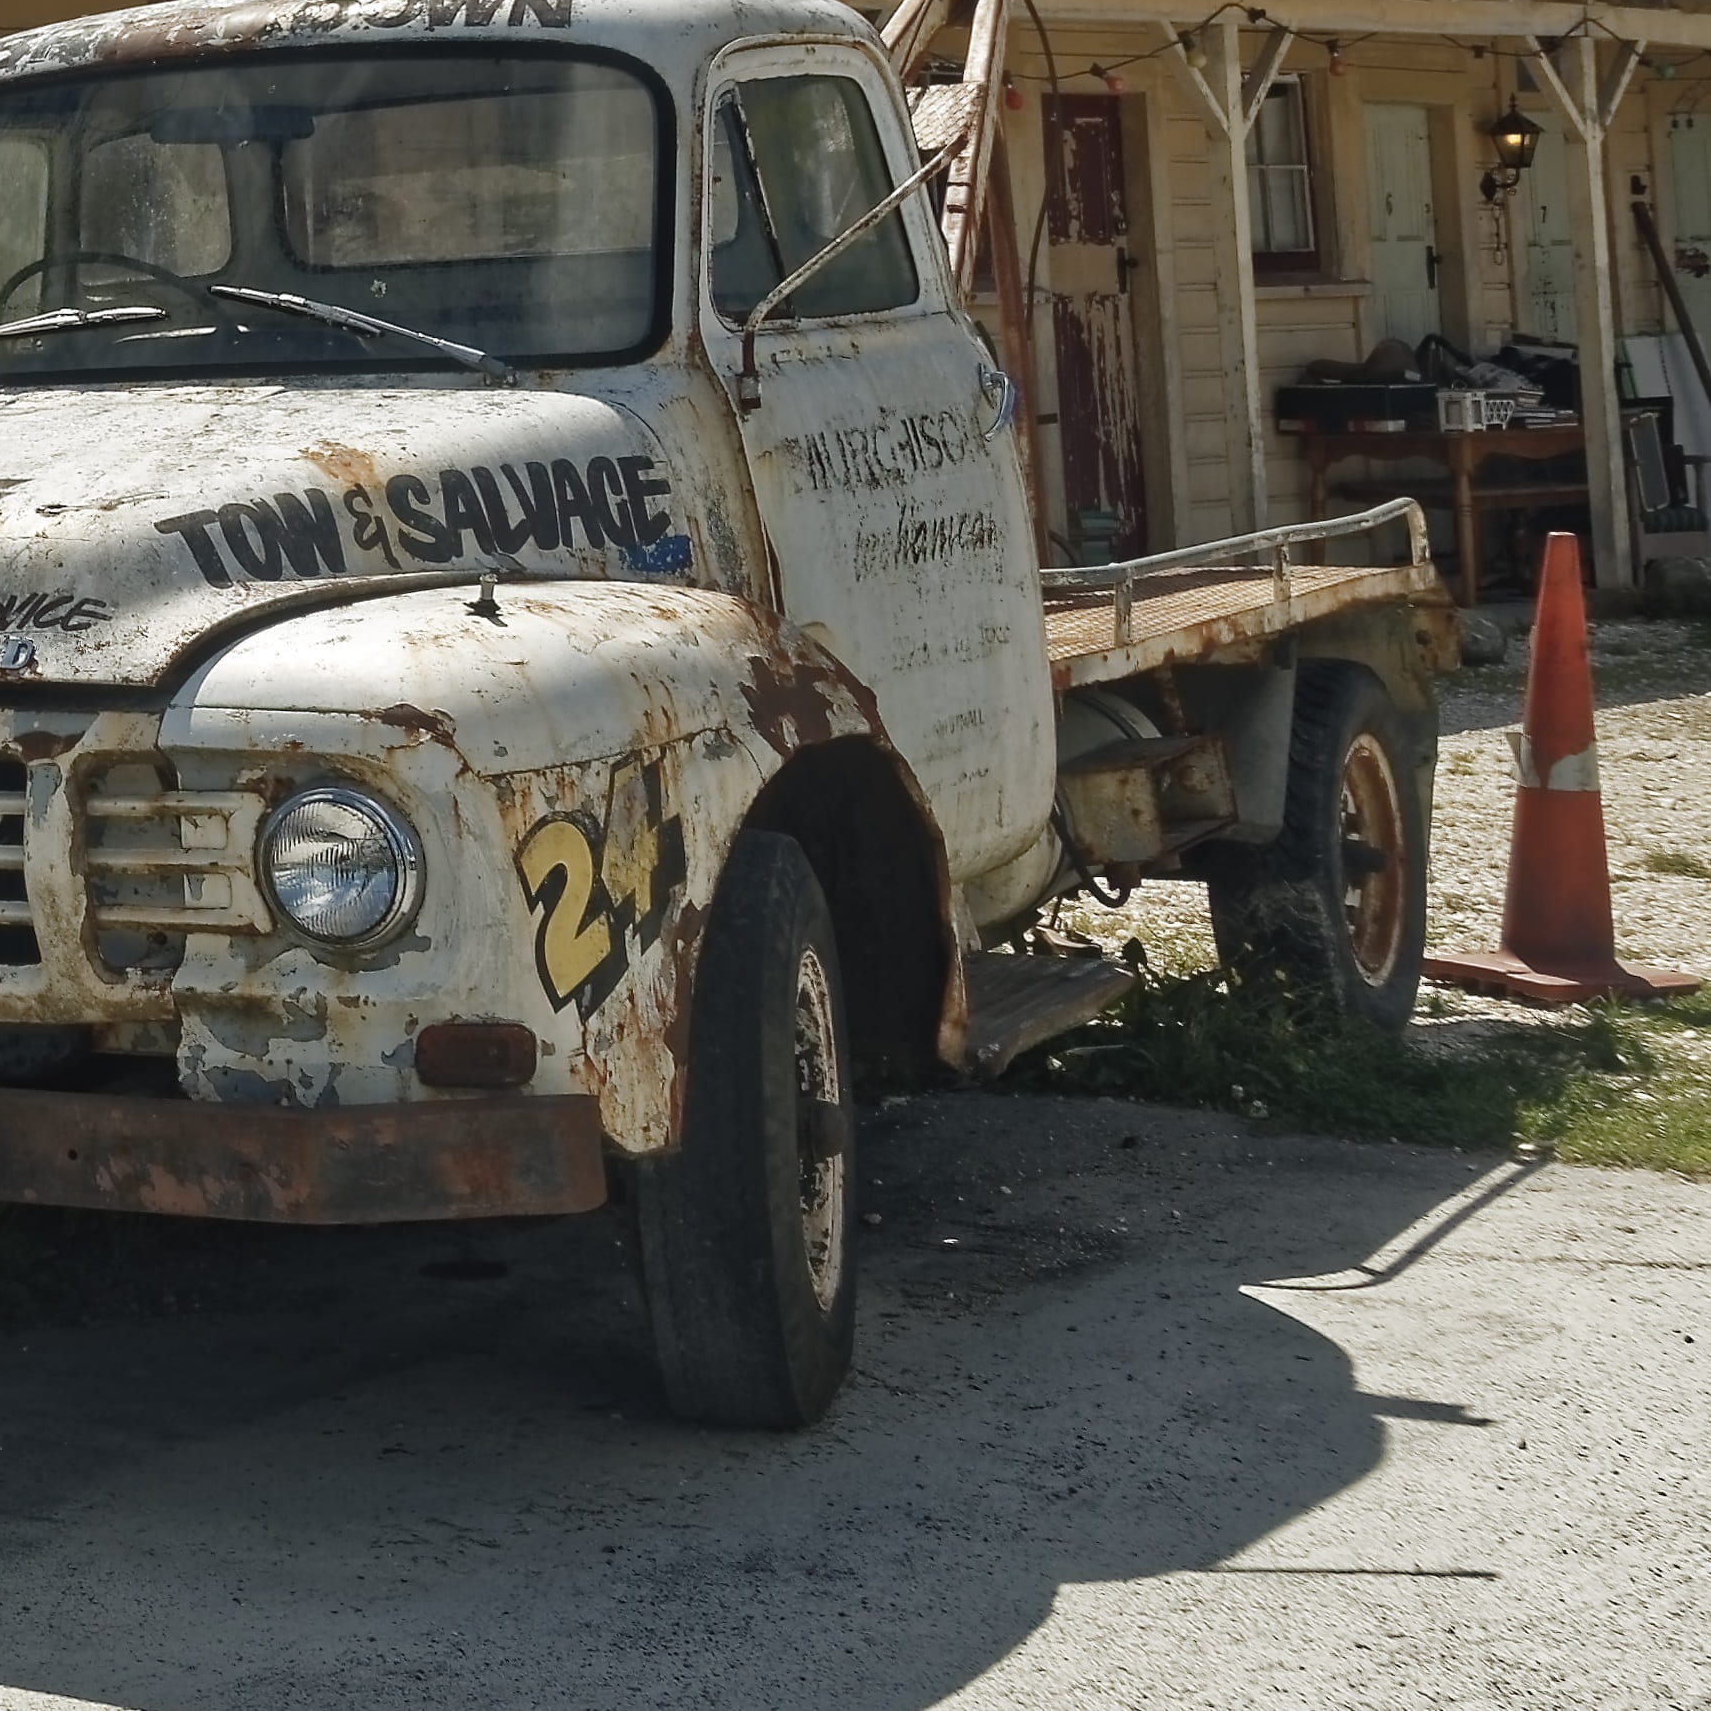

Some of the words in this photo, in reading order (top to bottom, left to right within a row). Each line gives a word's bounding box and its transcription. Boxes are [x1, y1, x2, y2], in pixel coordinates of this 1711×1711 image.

[153, 487, 348, 589] TOW
[343, 482, 402, 570] &
[385, 454, 672, 565] SALVAGE
